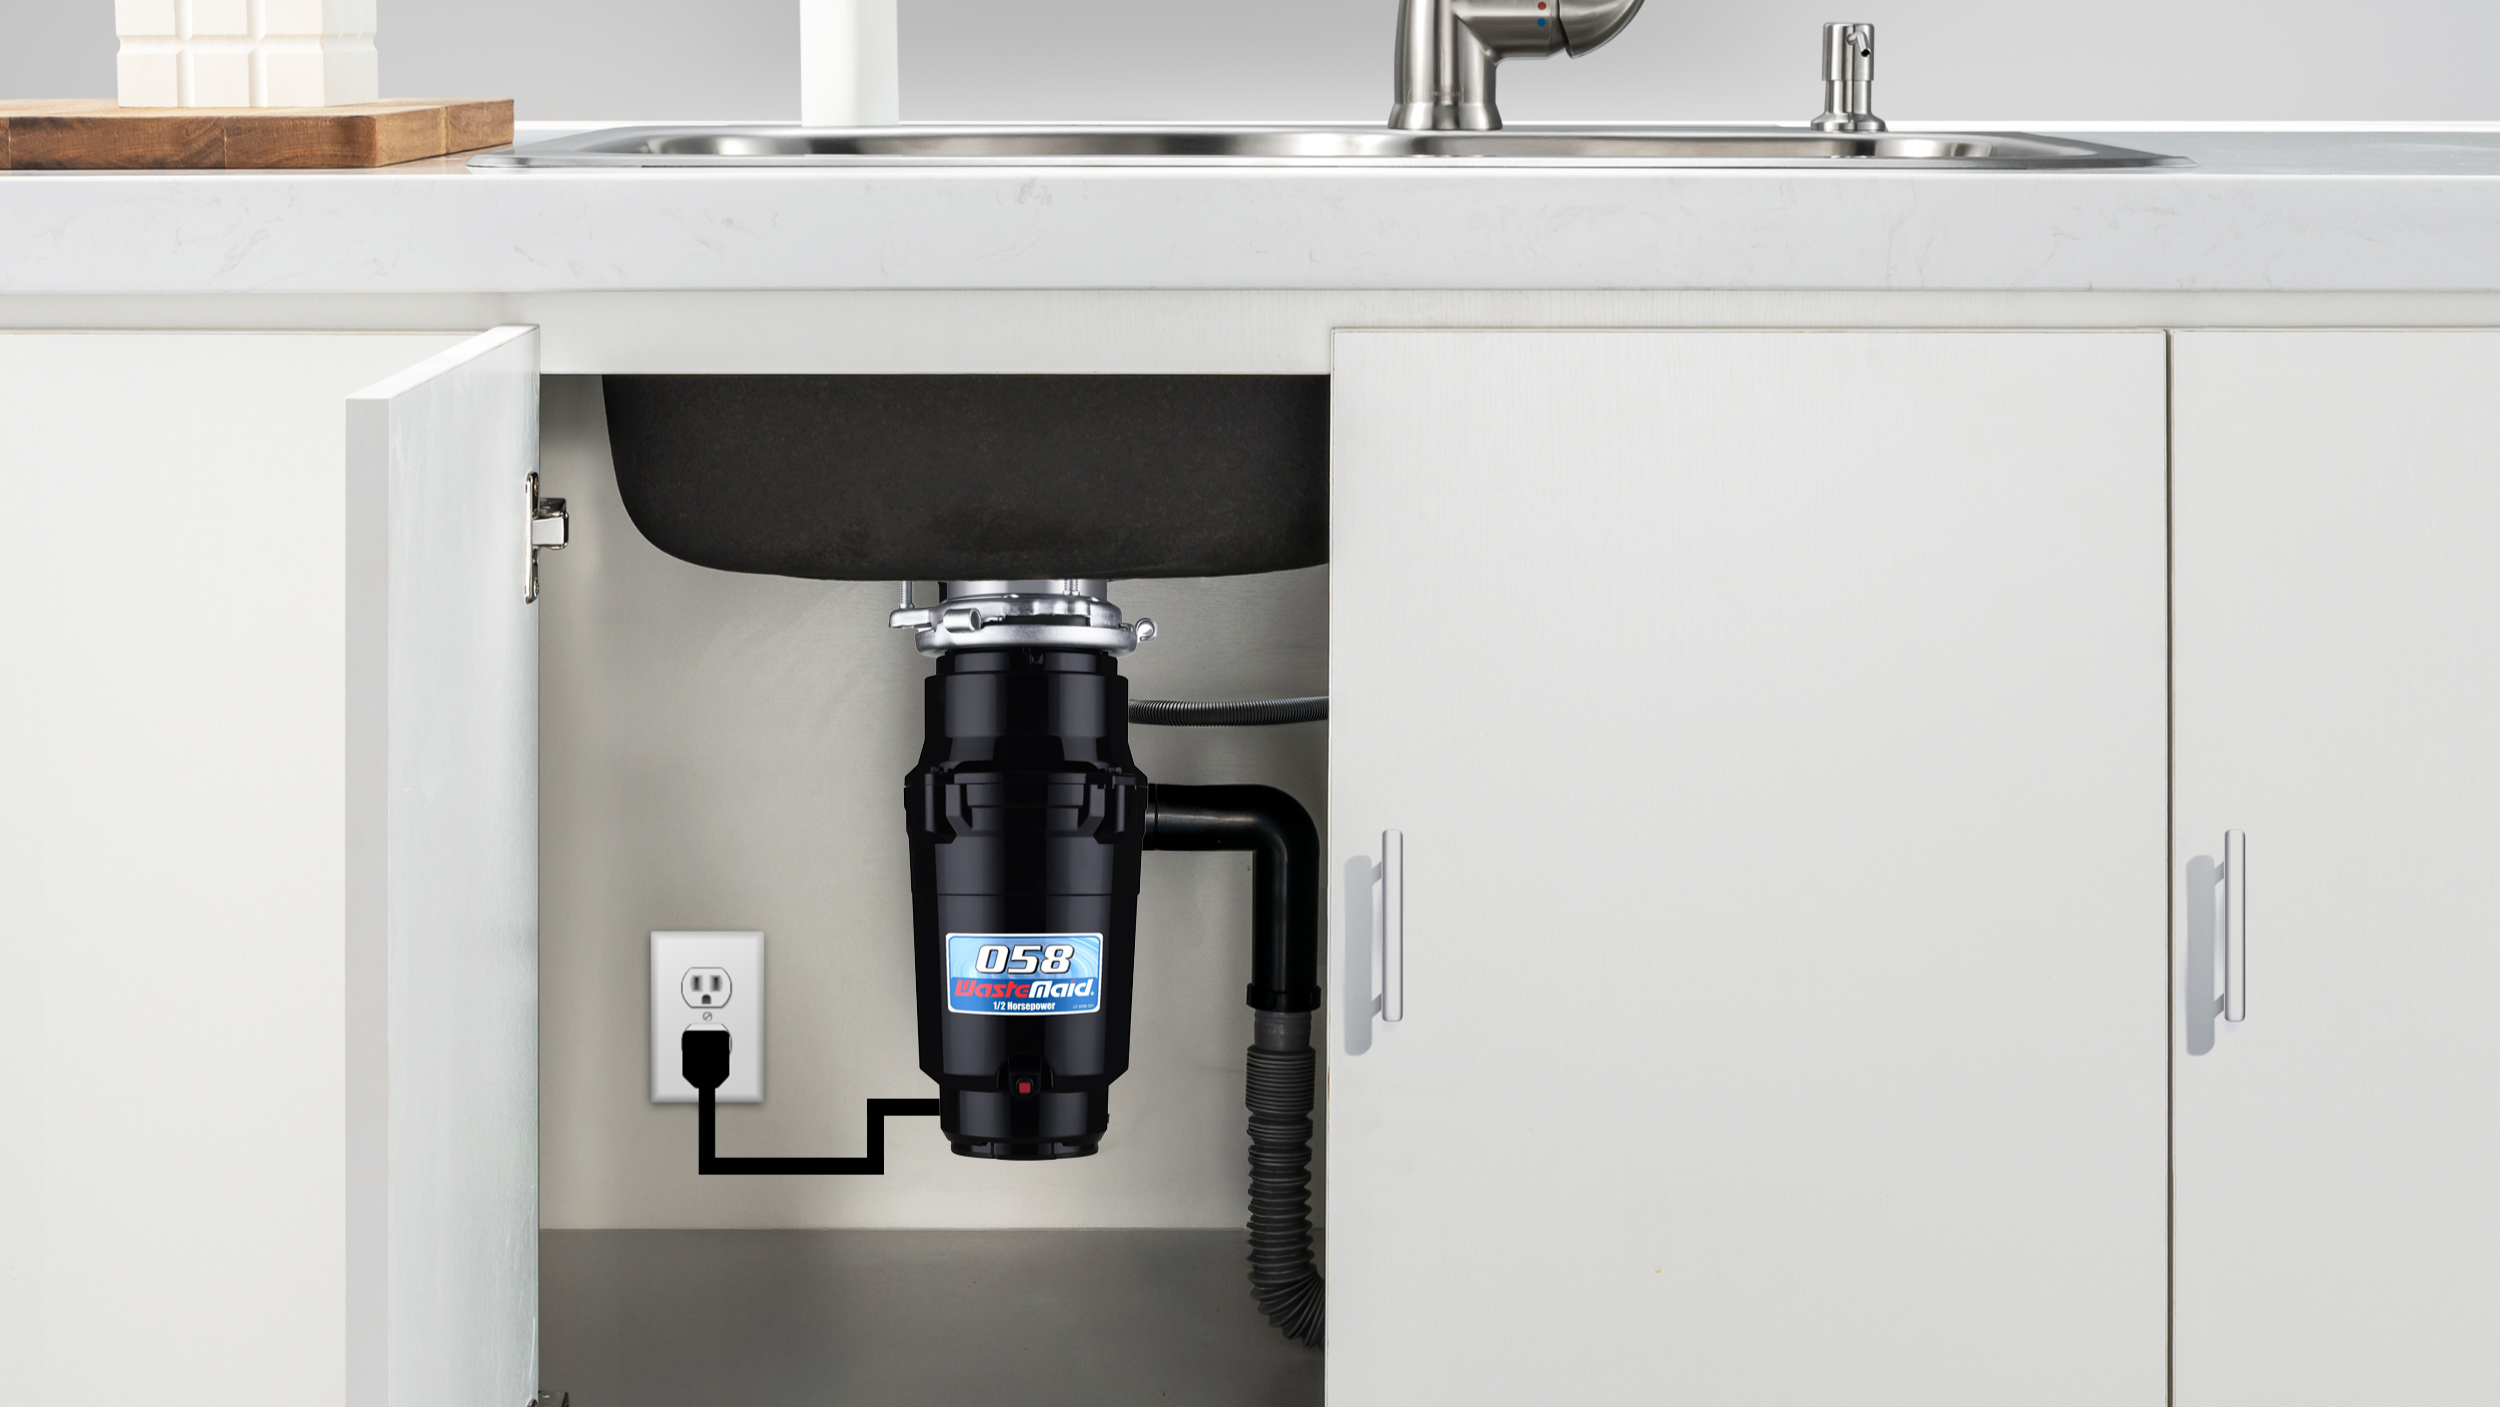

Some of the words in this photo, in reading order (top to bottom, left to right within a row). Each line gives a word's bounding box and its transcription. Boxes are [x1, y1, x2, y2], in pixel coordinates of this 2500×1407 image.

[975, 944, 1075, 974] 058
[993, 1001, 1006, 1011] 1/2
[1007, 1001, 1056, 1011] Horsepower
